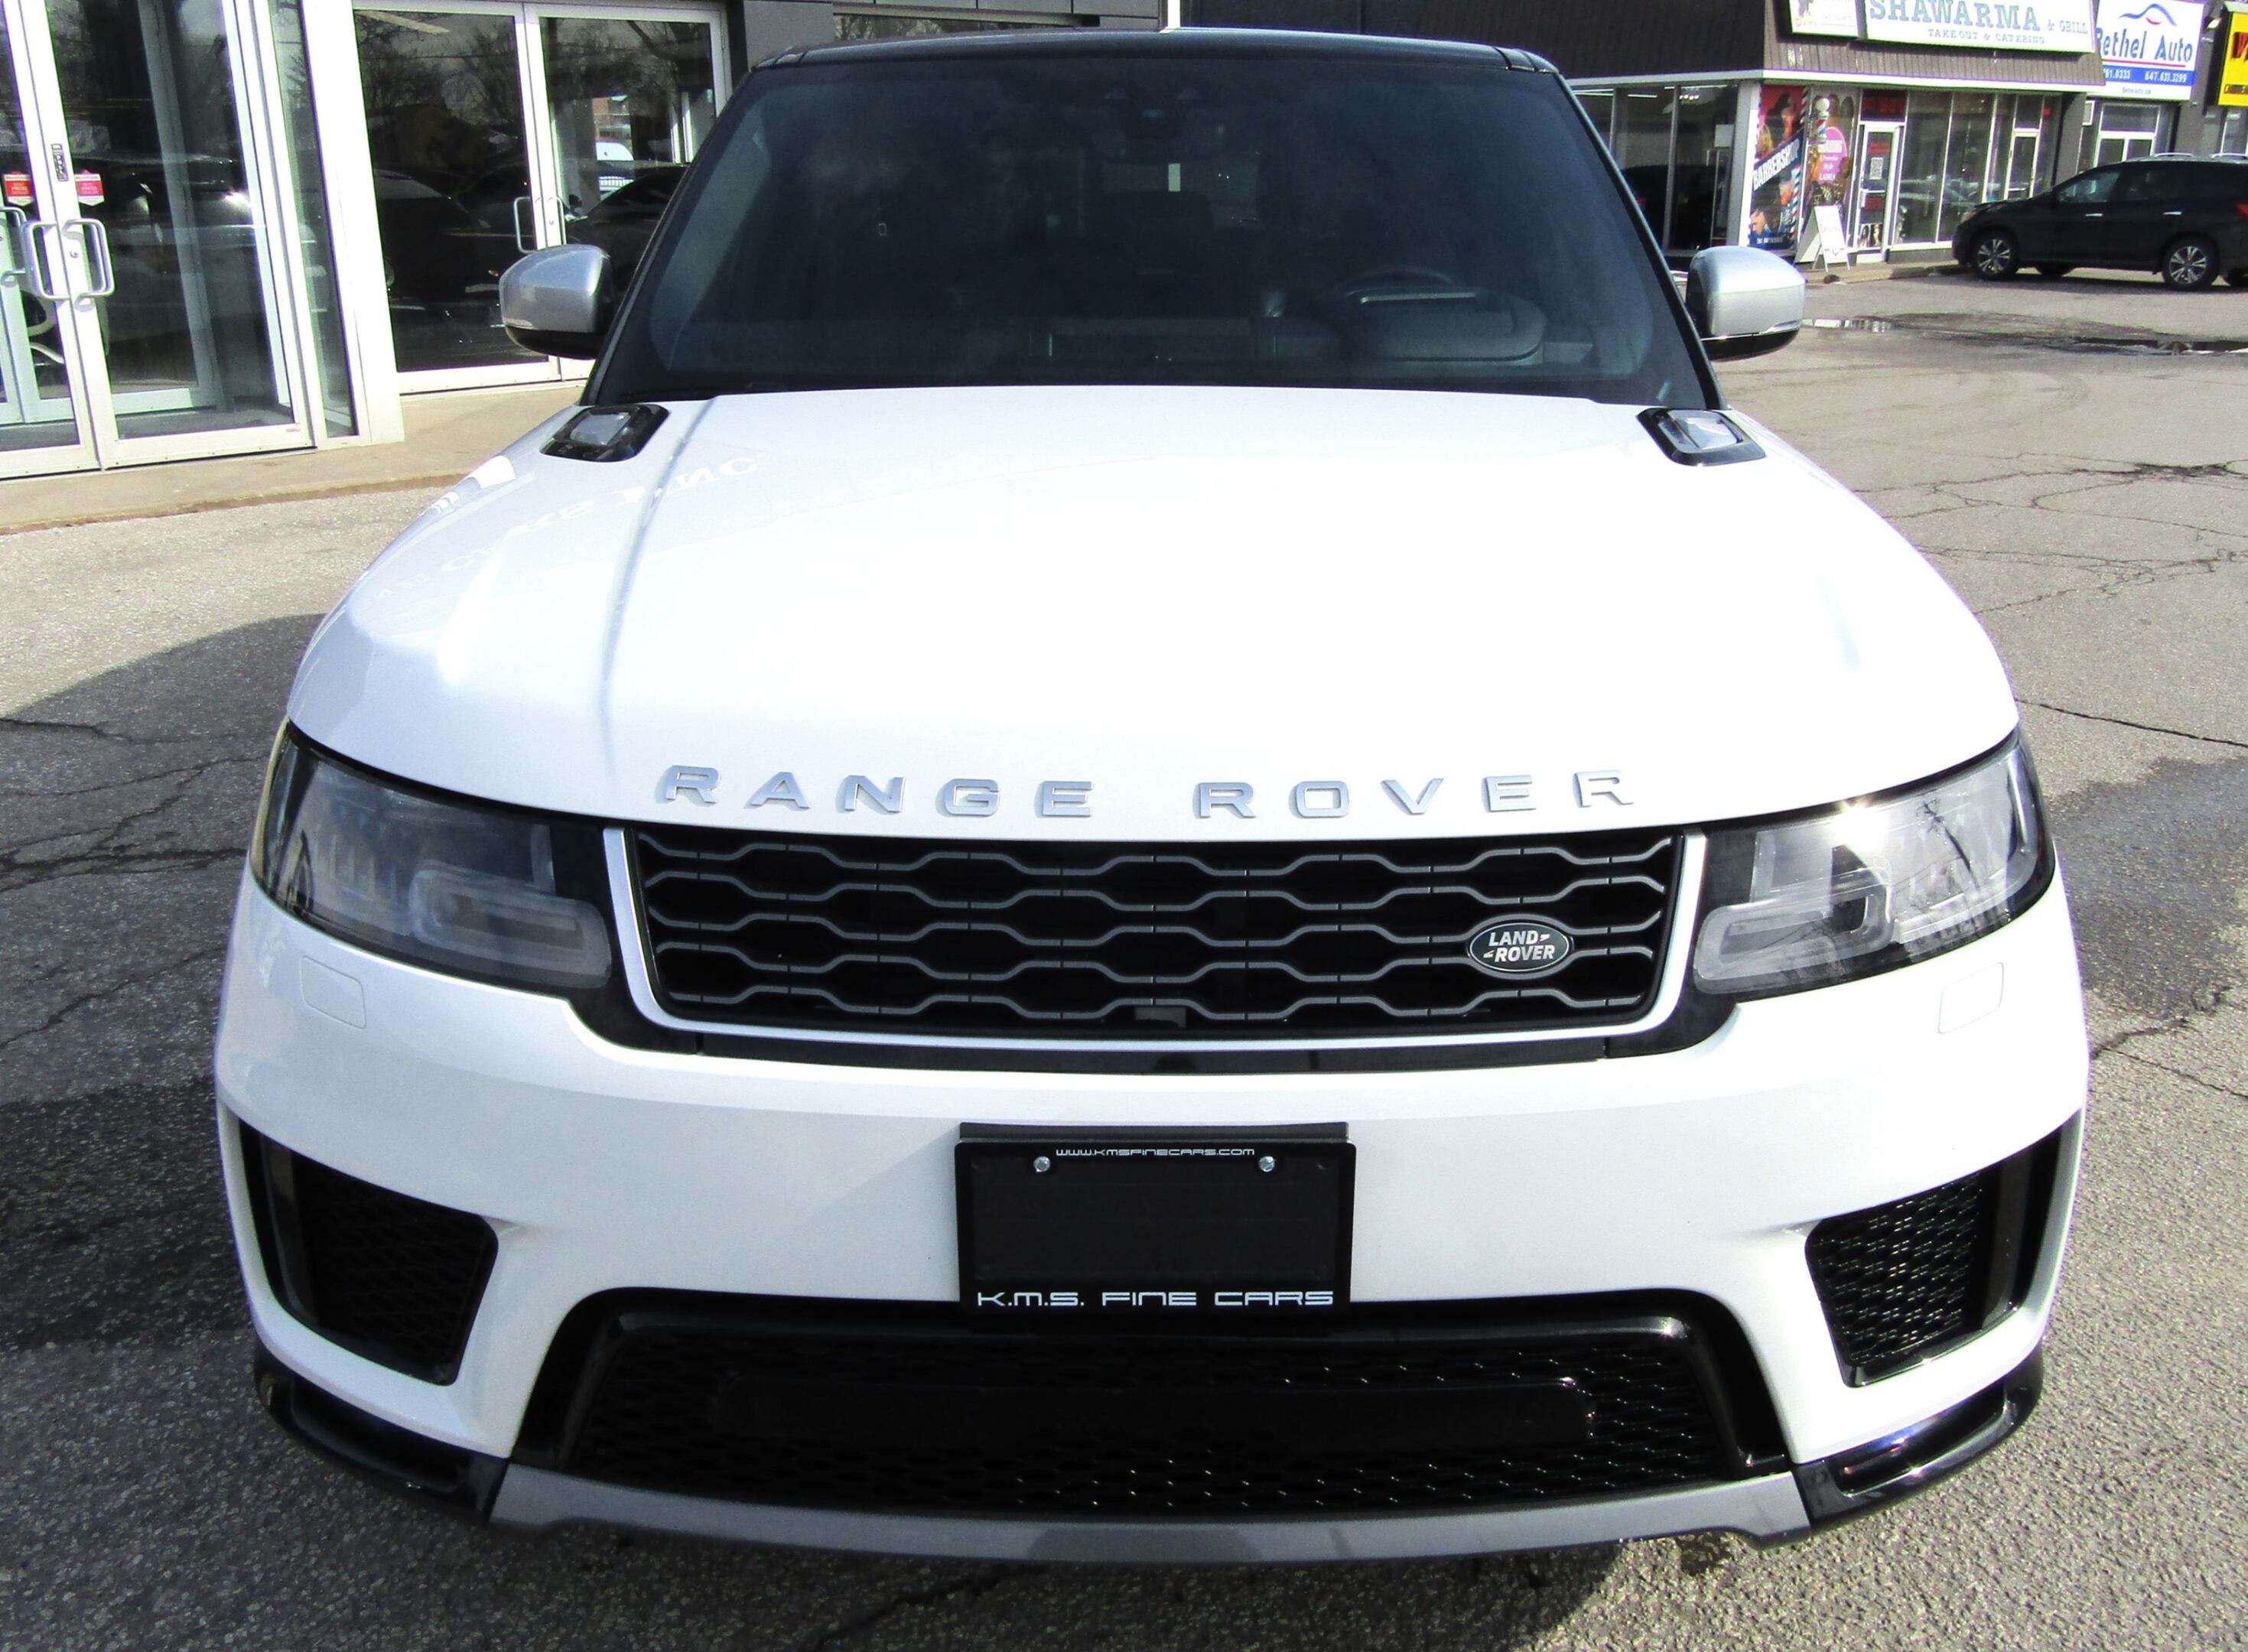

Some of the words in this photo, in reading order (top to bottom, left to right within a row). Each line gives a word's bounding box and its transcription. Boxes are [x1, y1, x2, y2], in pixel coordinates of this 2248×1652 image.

[1870, 0, 2041, 31] SHAWARMA
[2059, 21, 2088, 34] GRILL
[1996, 33, 2045, 44] CATERING
[2154, 34, 2193, 63] Auto
[663, 765, 1094, 818] RANGE
[1196, 770, 1634, 819] ROVER
[1488, 930, 1539, 947] LAND
[1495, 945, 1556, 962] ROVER
[978, 1291, 1085, 1306] K.M.S.
[1102, 1291, 1197, 1306] FINE
[1215, 1291, 1334, 1306] CARS
